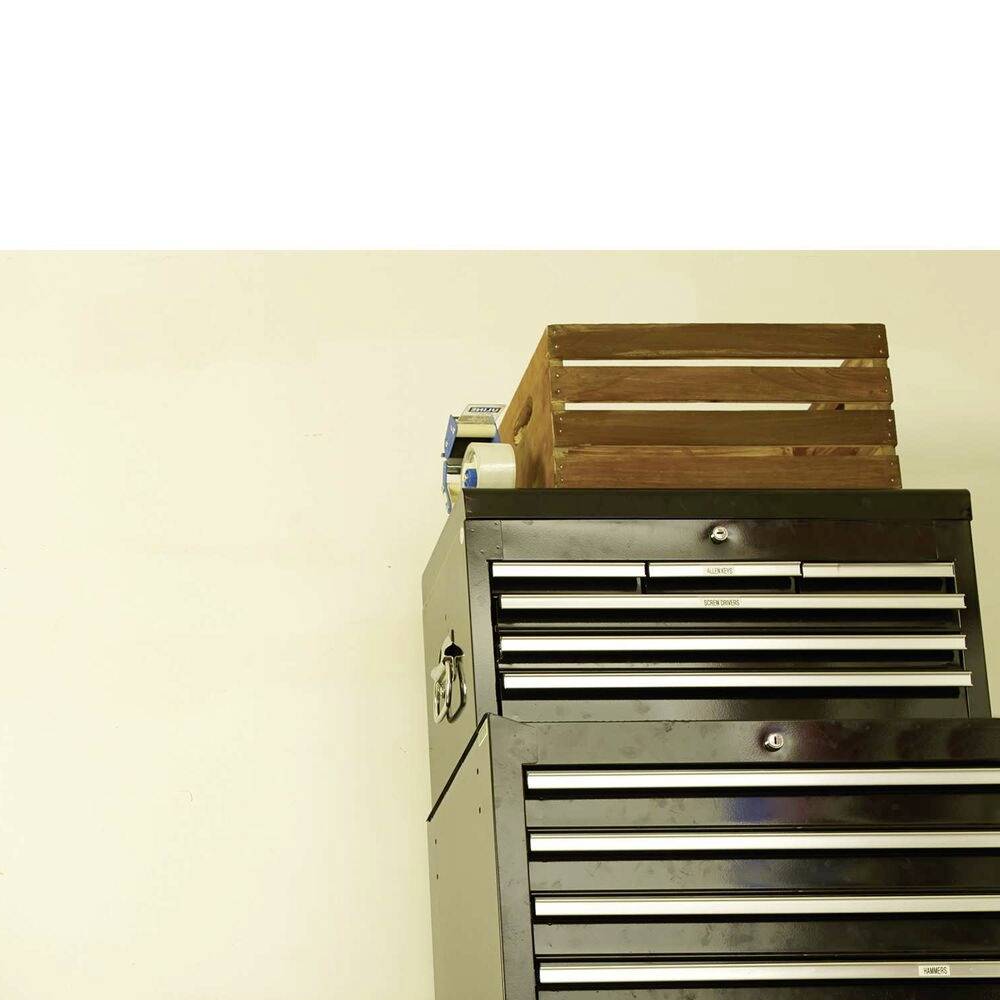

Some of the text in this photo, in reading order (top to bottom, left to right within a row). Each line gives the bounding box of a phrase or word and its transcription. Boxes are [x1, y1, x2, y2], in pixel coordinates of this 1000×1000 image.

[703, 599, 740, 607] SCREW DRIVERS
[923, 966, 948, 975] HAMMERS
